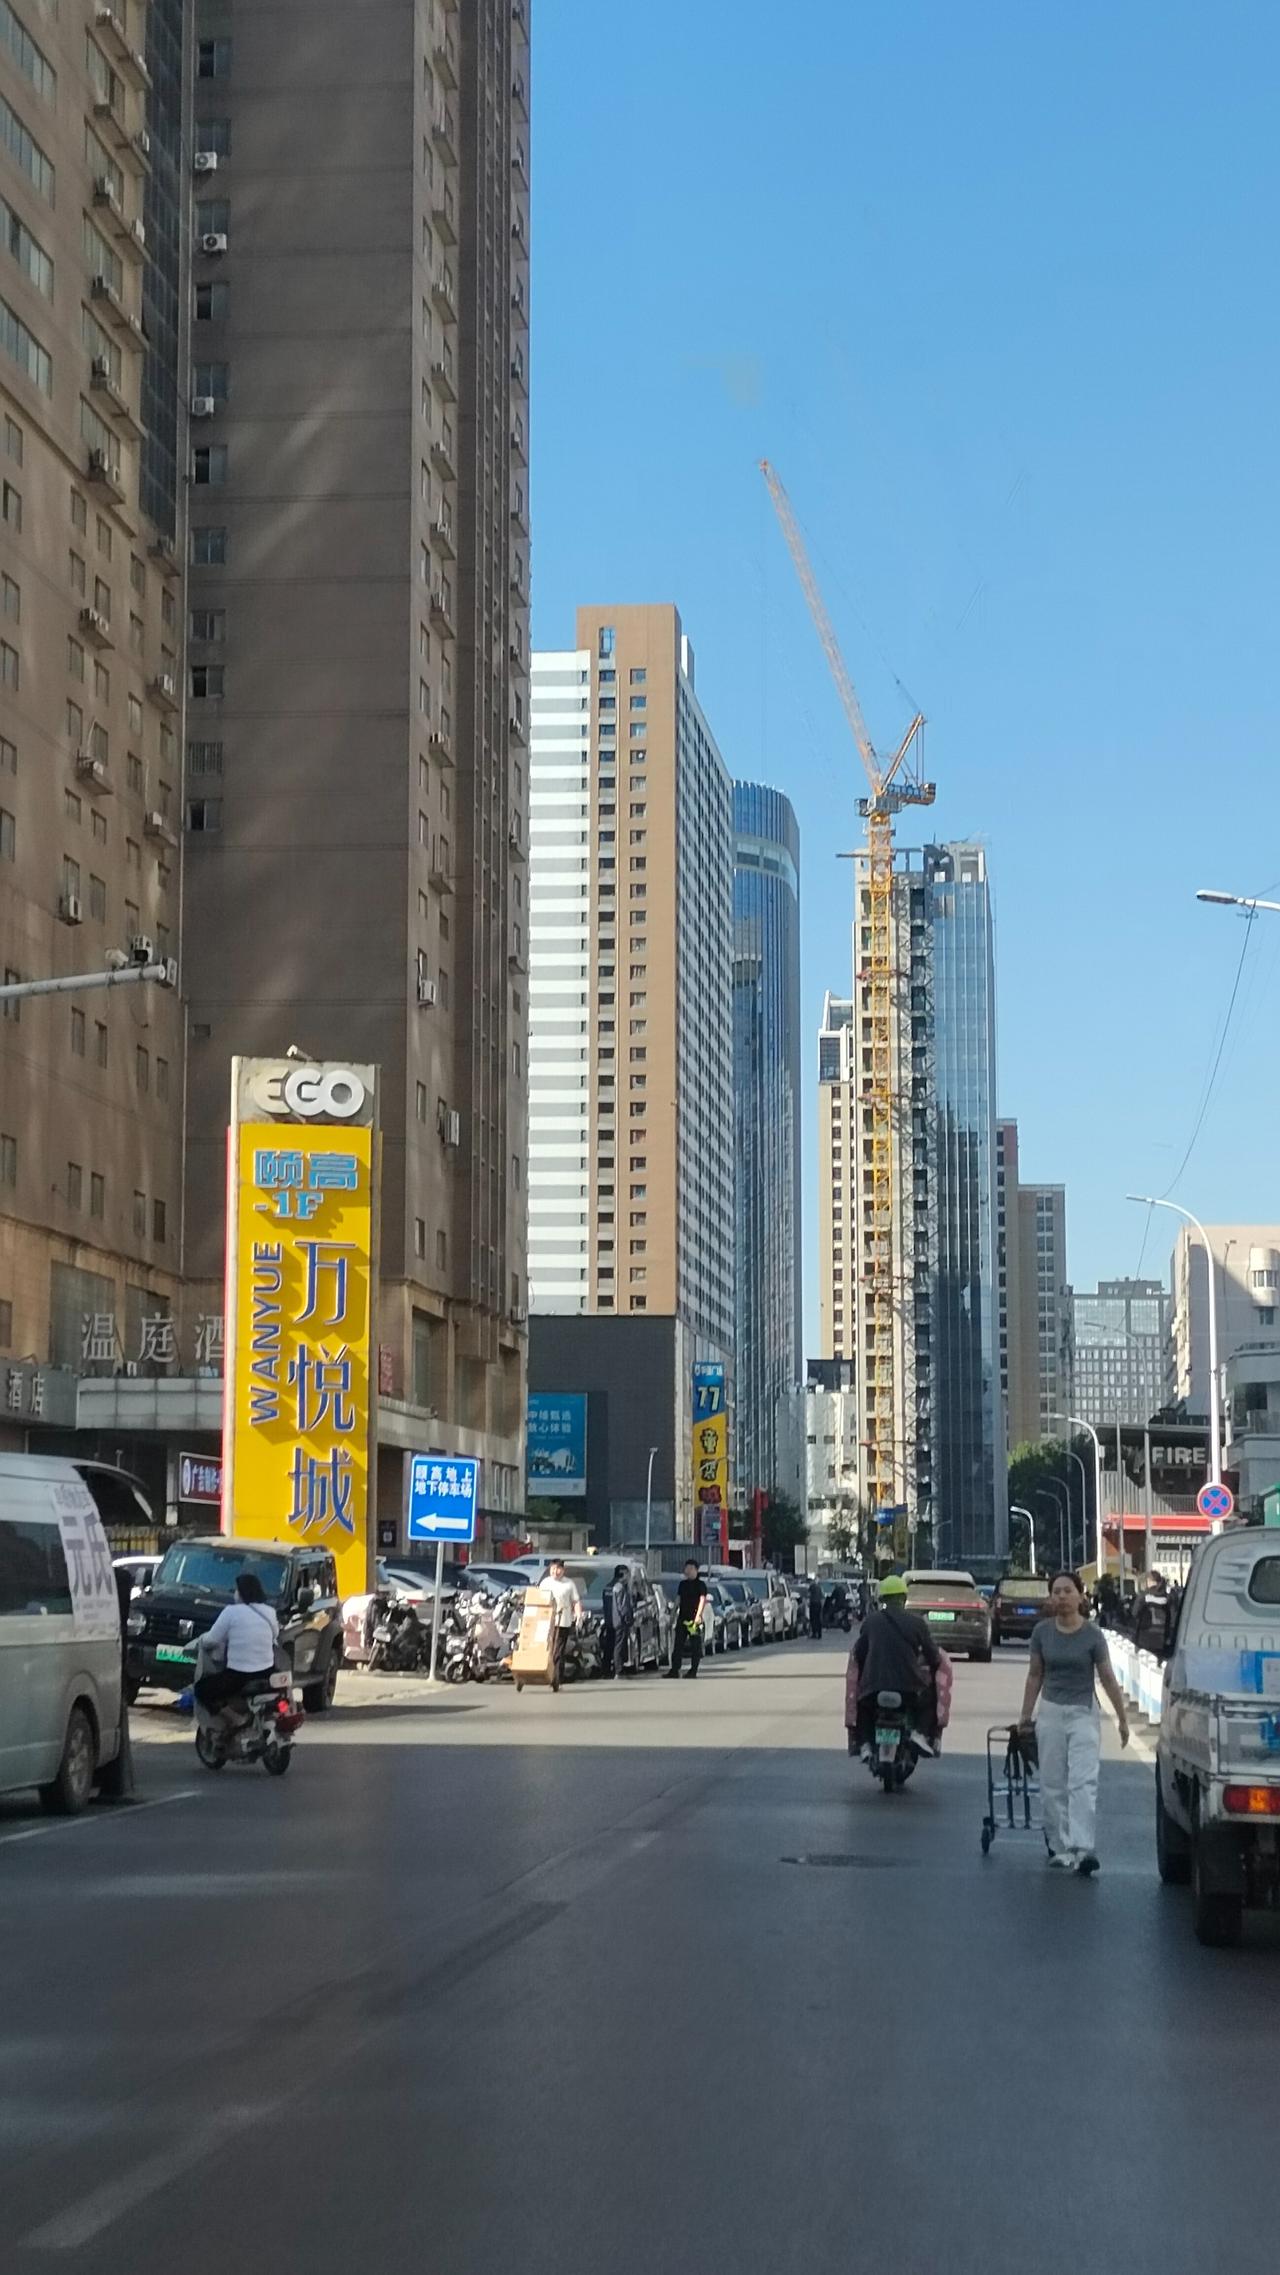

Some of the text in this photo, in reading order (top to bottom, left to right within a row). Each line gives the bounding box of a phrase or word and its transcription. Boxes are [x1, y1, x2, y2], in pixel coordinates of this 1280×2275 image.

[253, 1067, 365, 1118] EGO
[254, 1149, 358, 1190] 颐高
[249, 1241, 283, 1427] WANYUE
[286, 1239, 356, 1536] 万悦城
[698, 1386, 720, 1411] 77
[415, 1465, 472, 1483] 颐高地上
[1152, 1447, 1206, 1464] FIRE
[414, 1479, 472, 1498] 地下停车场
[62, 1512, 113, 1597] 元氏
